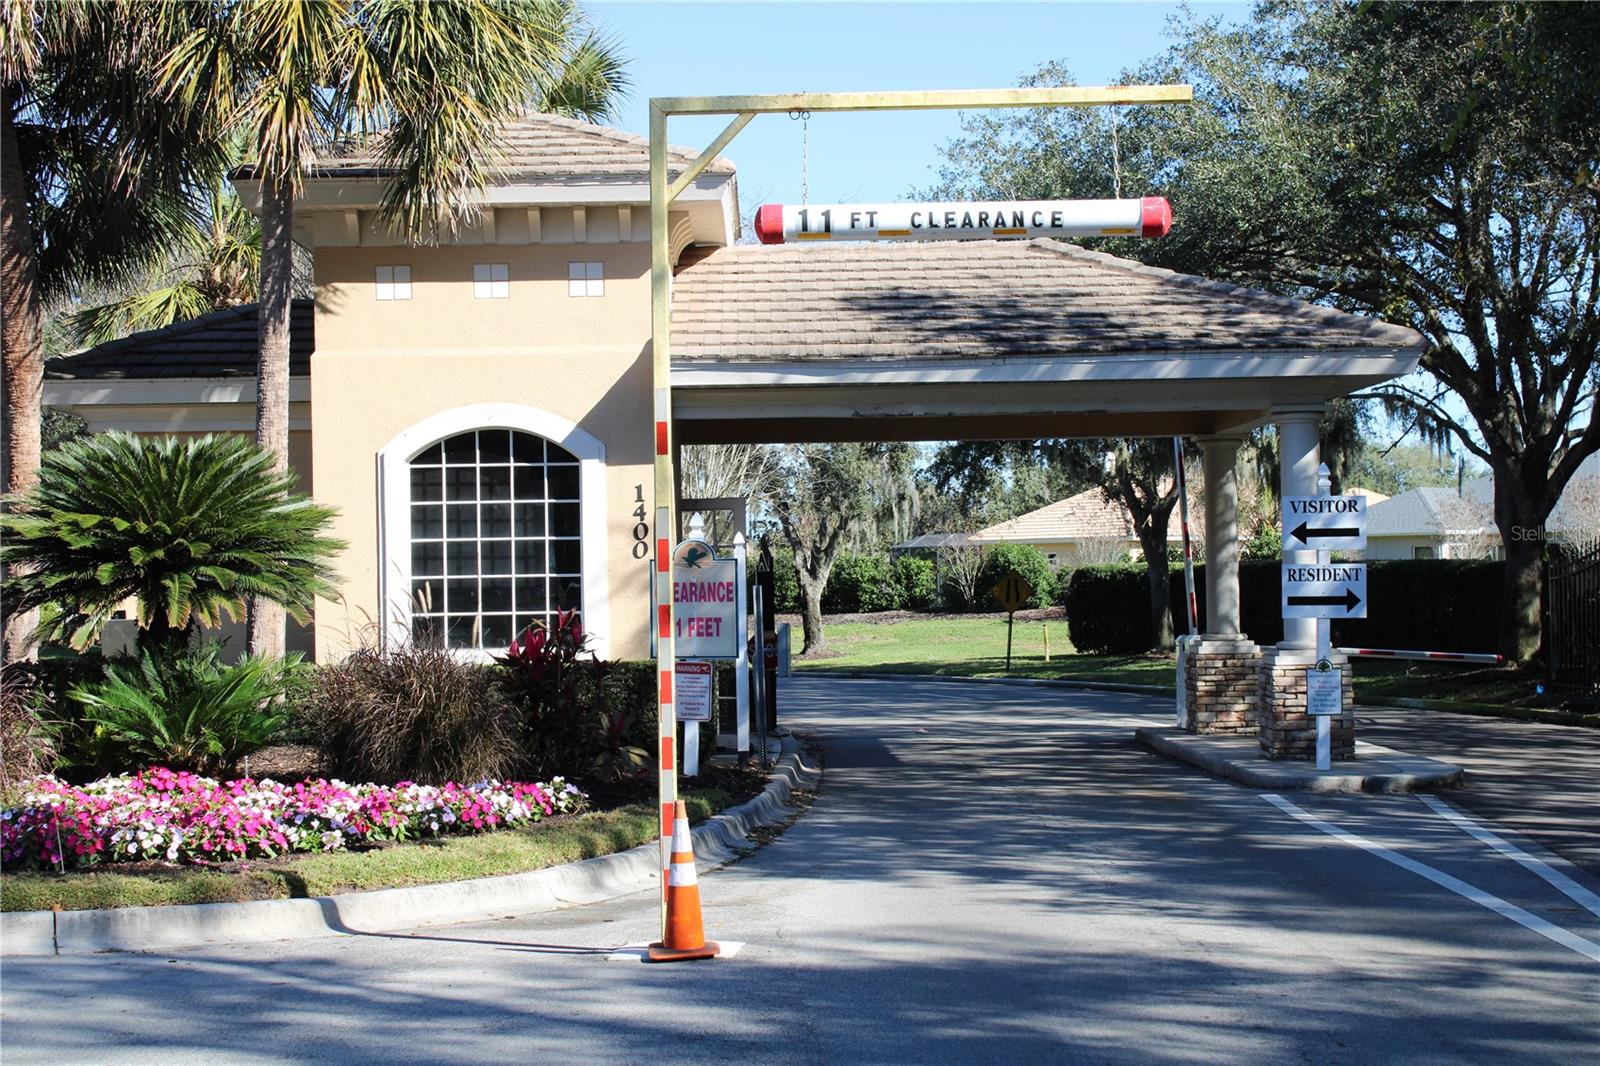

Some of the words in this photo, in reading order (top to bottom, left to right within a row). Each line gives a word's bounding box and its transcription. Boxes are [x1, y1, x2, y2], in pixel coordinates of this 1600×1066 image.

[798, 208, 831, 232] 11
[850, 211, 878, 228] FT
[910, 211, 1063, 229] CLEARANCE
[1290, 500, 1359, 513] VISITOR
[632, 484, 649, 559] 1400
[1287, 568, 1361, 582] RESIDENT
[673, 582, 734, 602] EARANCE
[688, 617, 722, 637] FEET
